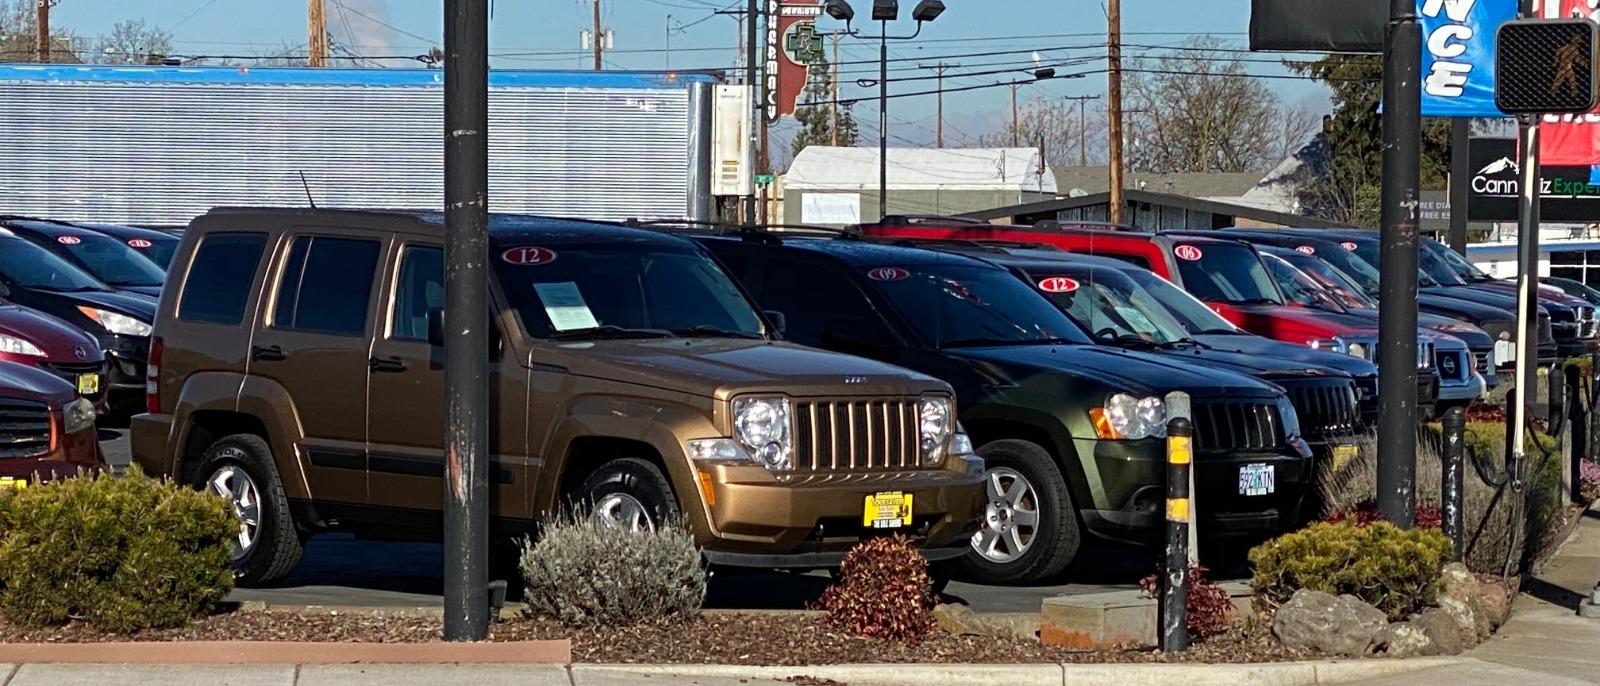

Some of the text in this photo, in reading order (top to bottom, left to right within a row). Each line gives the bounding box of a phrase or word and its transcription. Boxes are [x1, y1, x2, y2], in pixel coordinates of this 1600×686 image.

[521, 248, 540, 264] 12
[879, 267, 897, 280] 09
[1051, 278, 1068, 291] 12
